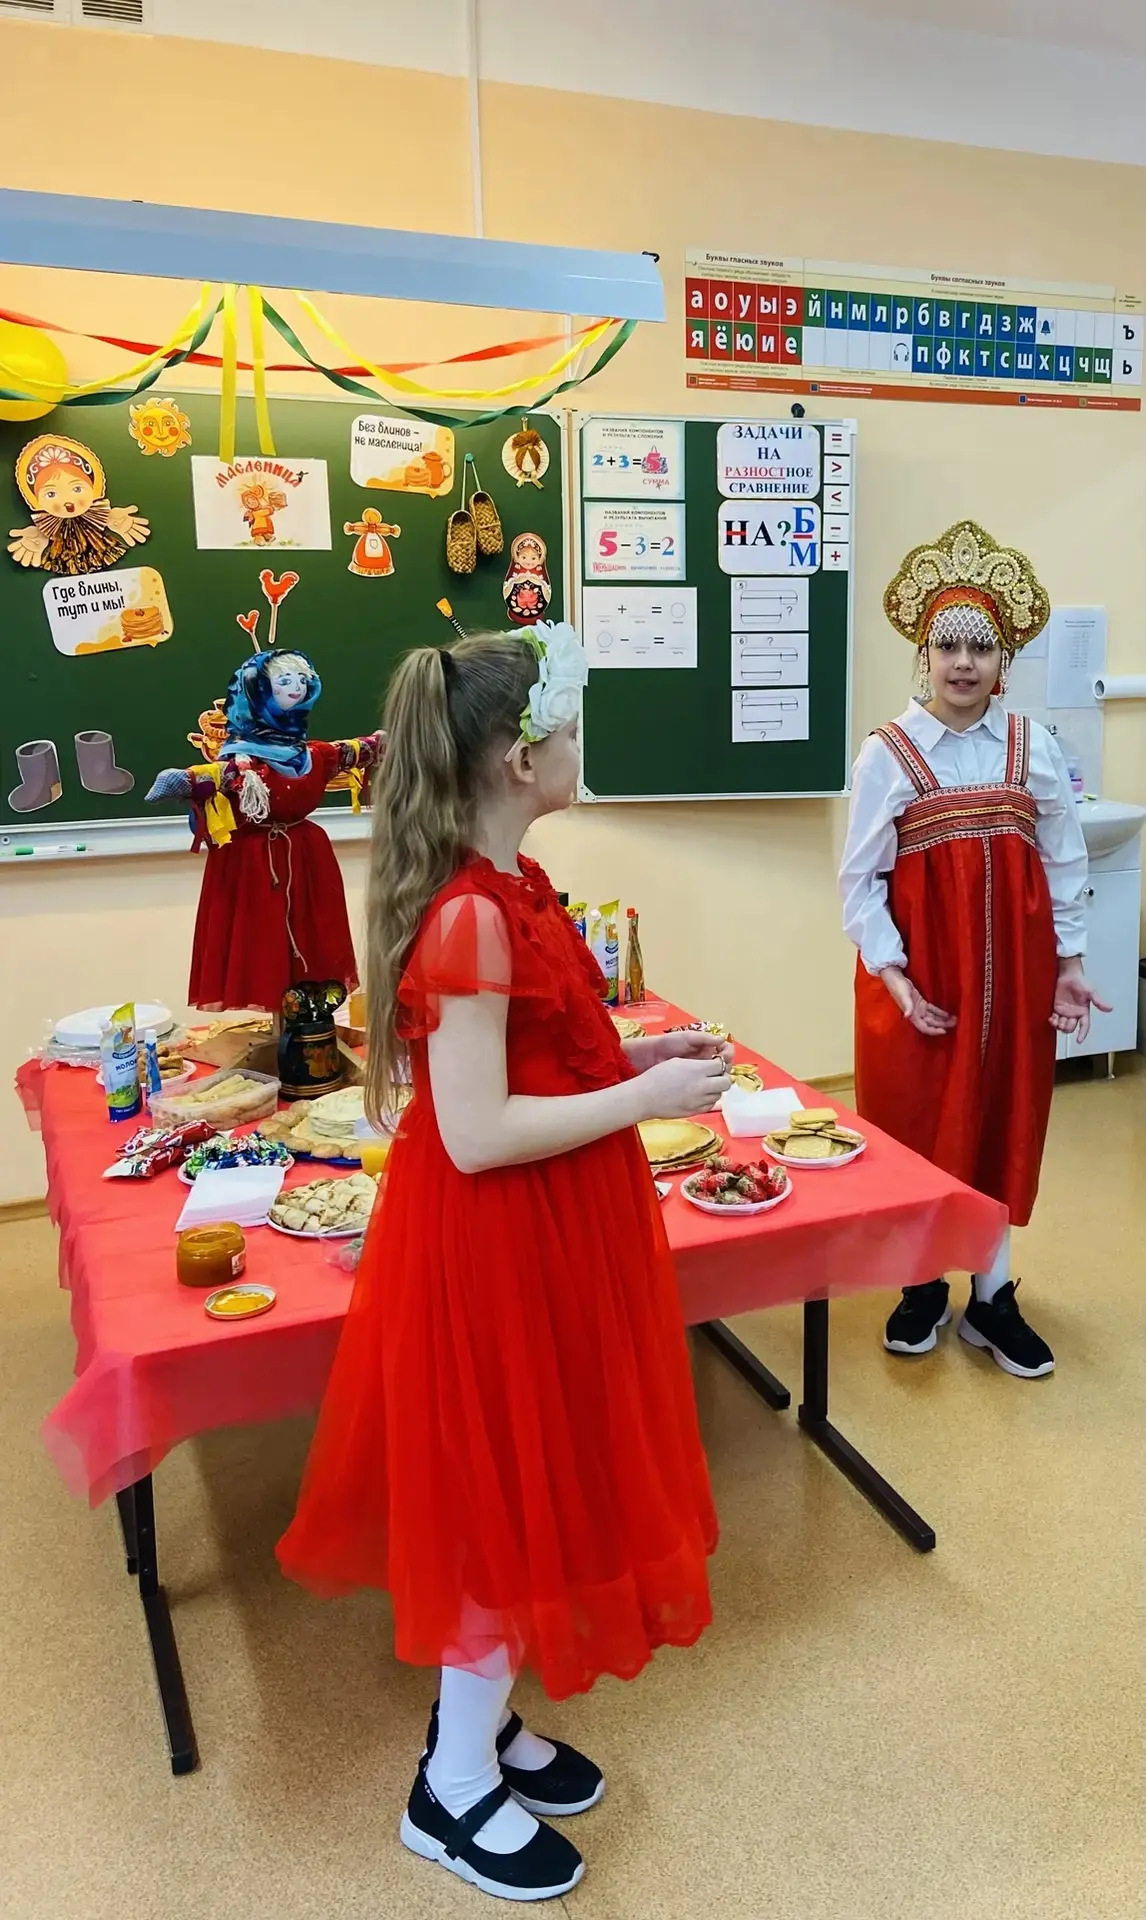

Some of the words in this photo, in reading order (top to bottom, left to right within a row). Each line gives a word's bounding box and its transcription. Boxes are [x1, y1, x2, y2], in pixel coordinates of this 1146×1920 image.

[706, 253, 728, 262] Буквы
[730, 257, 758, 265] гласных
[760, 259, 783, 267] звуков
[931, 274, 950, 282] Буквы
[952, 277, 983, 285] согласных
[359, 420, 375, 431] Без
[378, 421, 411, 437] блинов
[734, 425, 802, 440] ЗАДАЧИ
[354, 436, 366, 445] не
[368, 438, 422, 452] масленица!
[757, 447, 781, 460] НА
[215, 460, 301, 488] МАСЛЕНИЦА
[725, 466, 813, 478] РАЗНОСТНОЕ
[729, 483, 810, 494] СРАВНЕНИЕ
[52, 586, 76, 603] Где
[78, 580, 123, 597] блины,
[57, 603, 88, 620] тут
[91, 602, 100, 612] и
[102, 596, 126, 611] мы!
